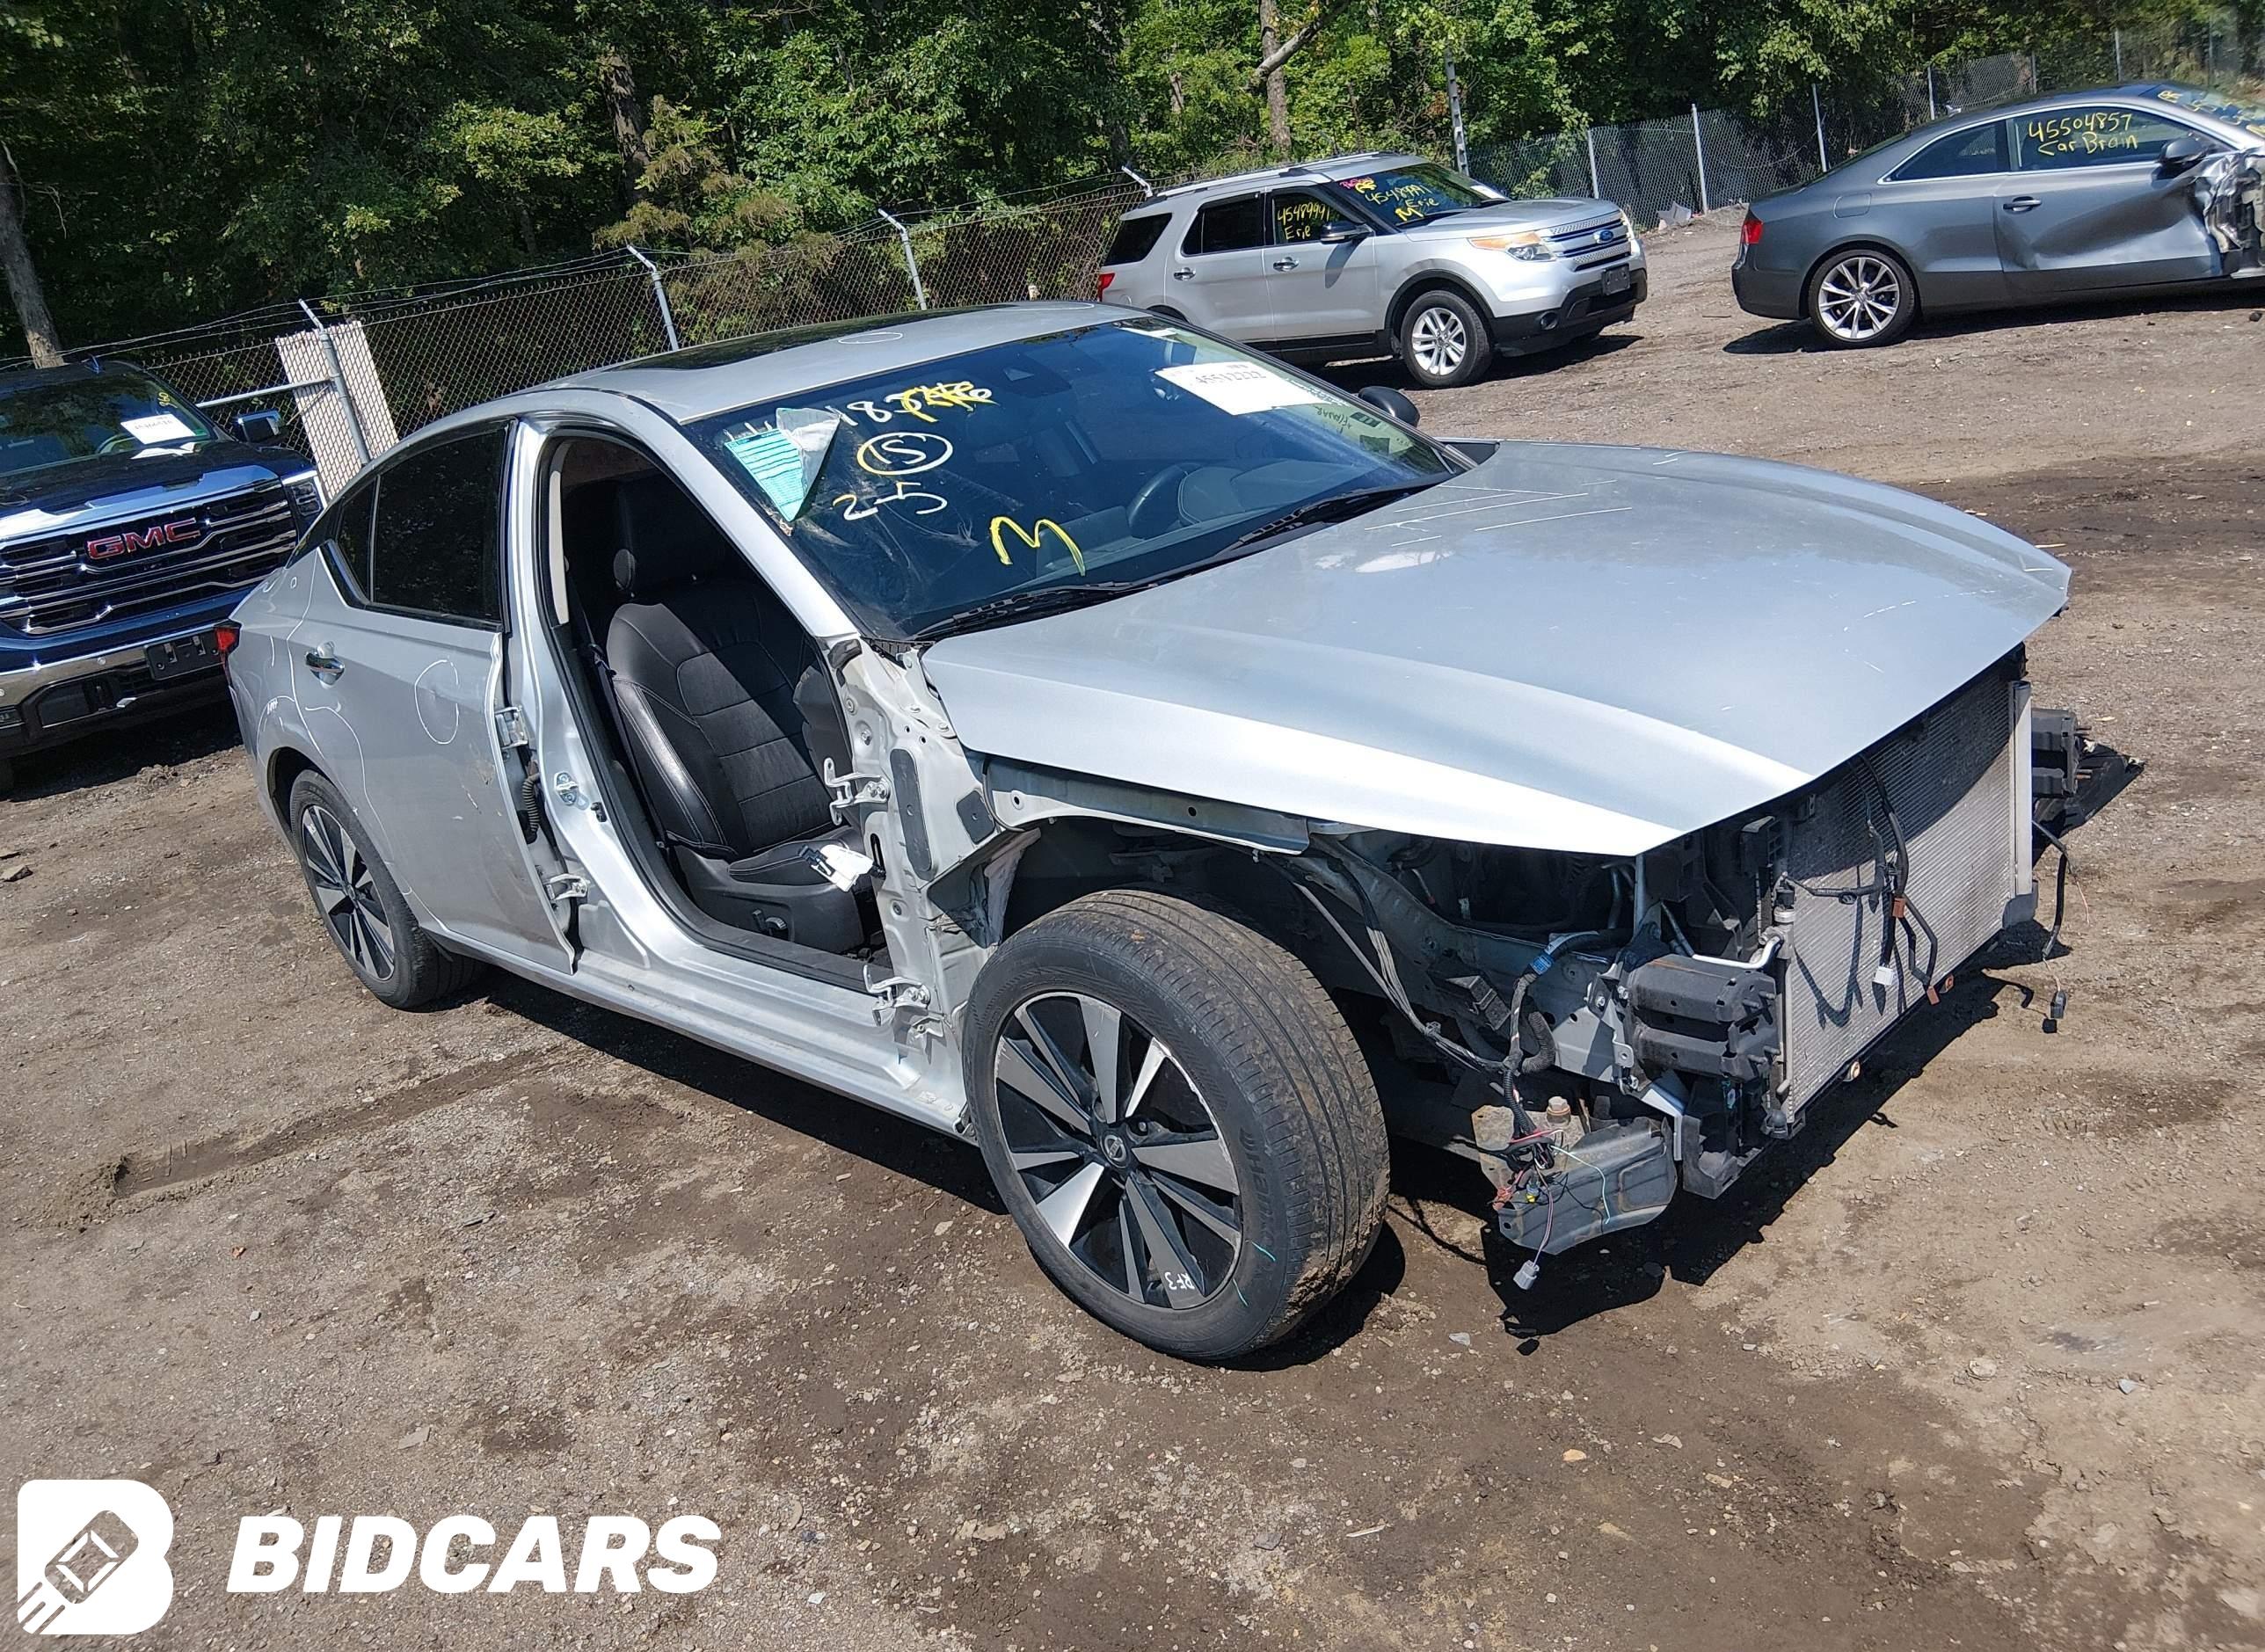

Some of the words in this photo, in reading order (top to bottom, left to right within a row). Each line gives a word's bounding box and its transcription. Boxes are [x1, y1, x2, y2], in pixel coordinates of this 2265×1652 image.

[2028, 113, 2132, 142] 45504857
[2037, 140, 2077, 156] Car
[2081, 131, 2138, 154] Brain
[1285, 222, 1311, 240] Erie
[87, 517, 201, 560] GMC
